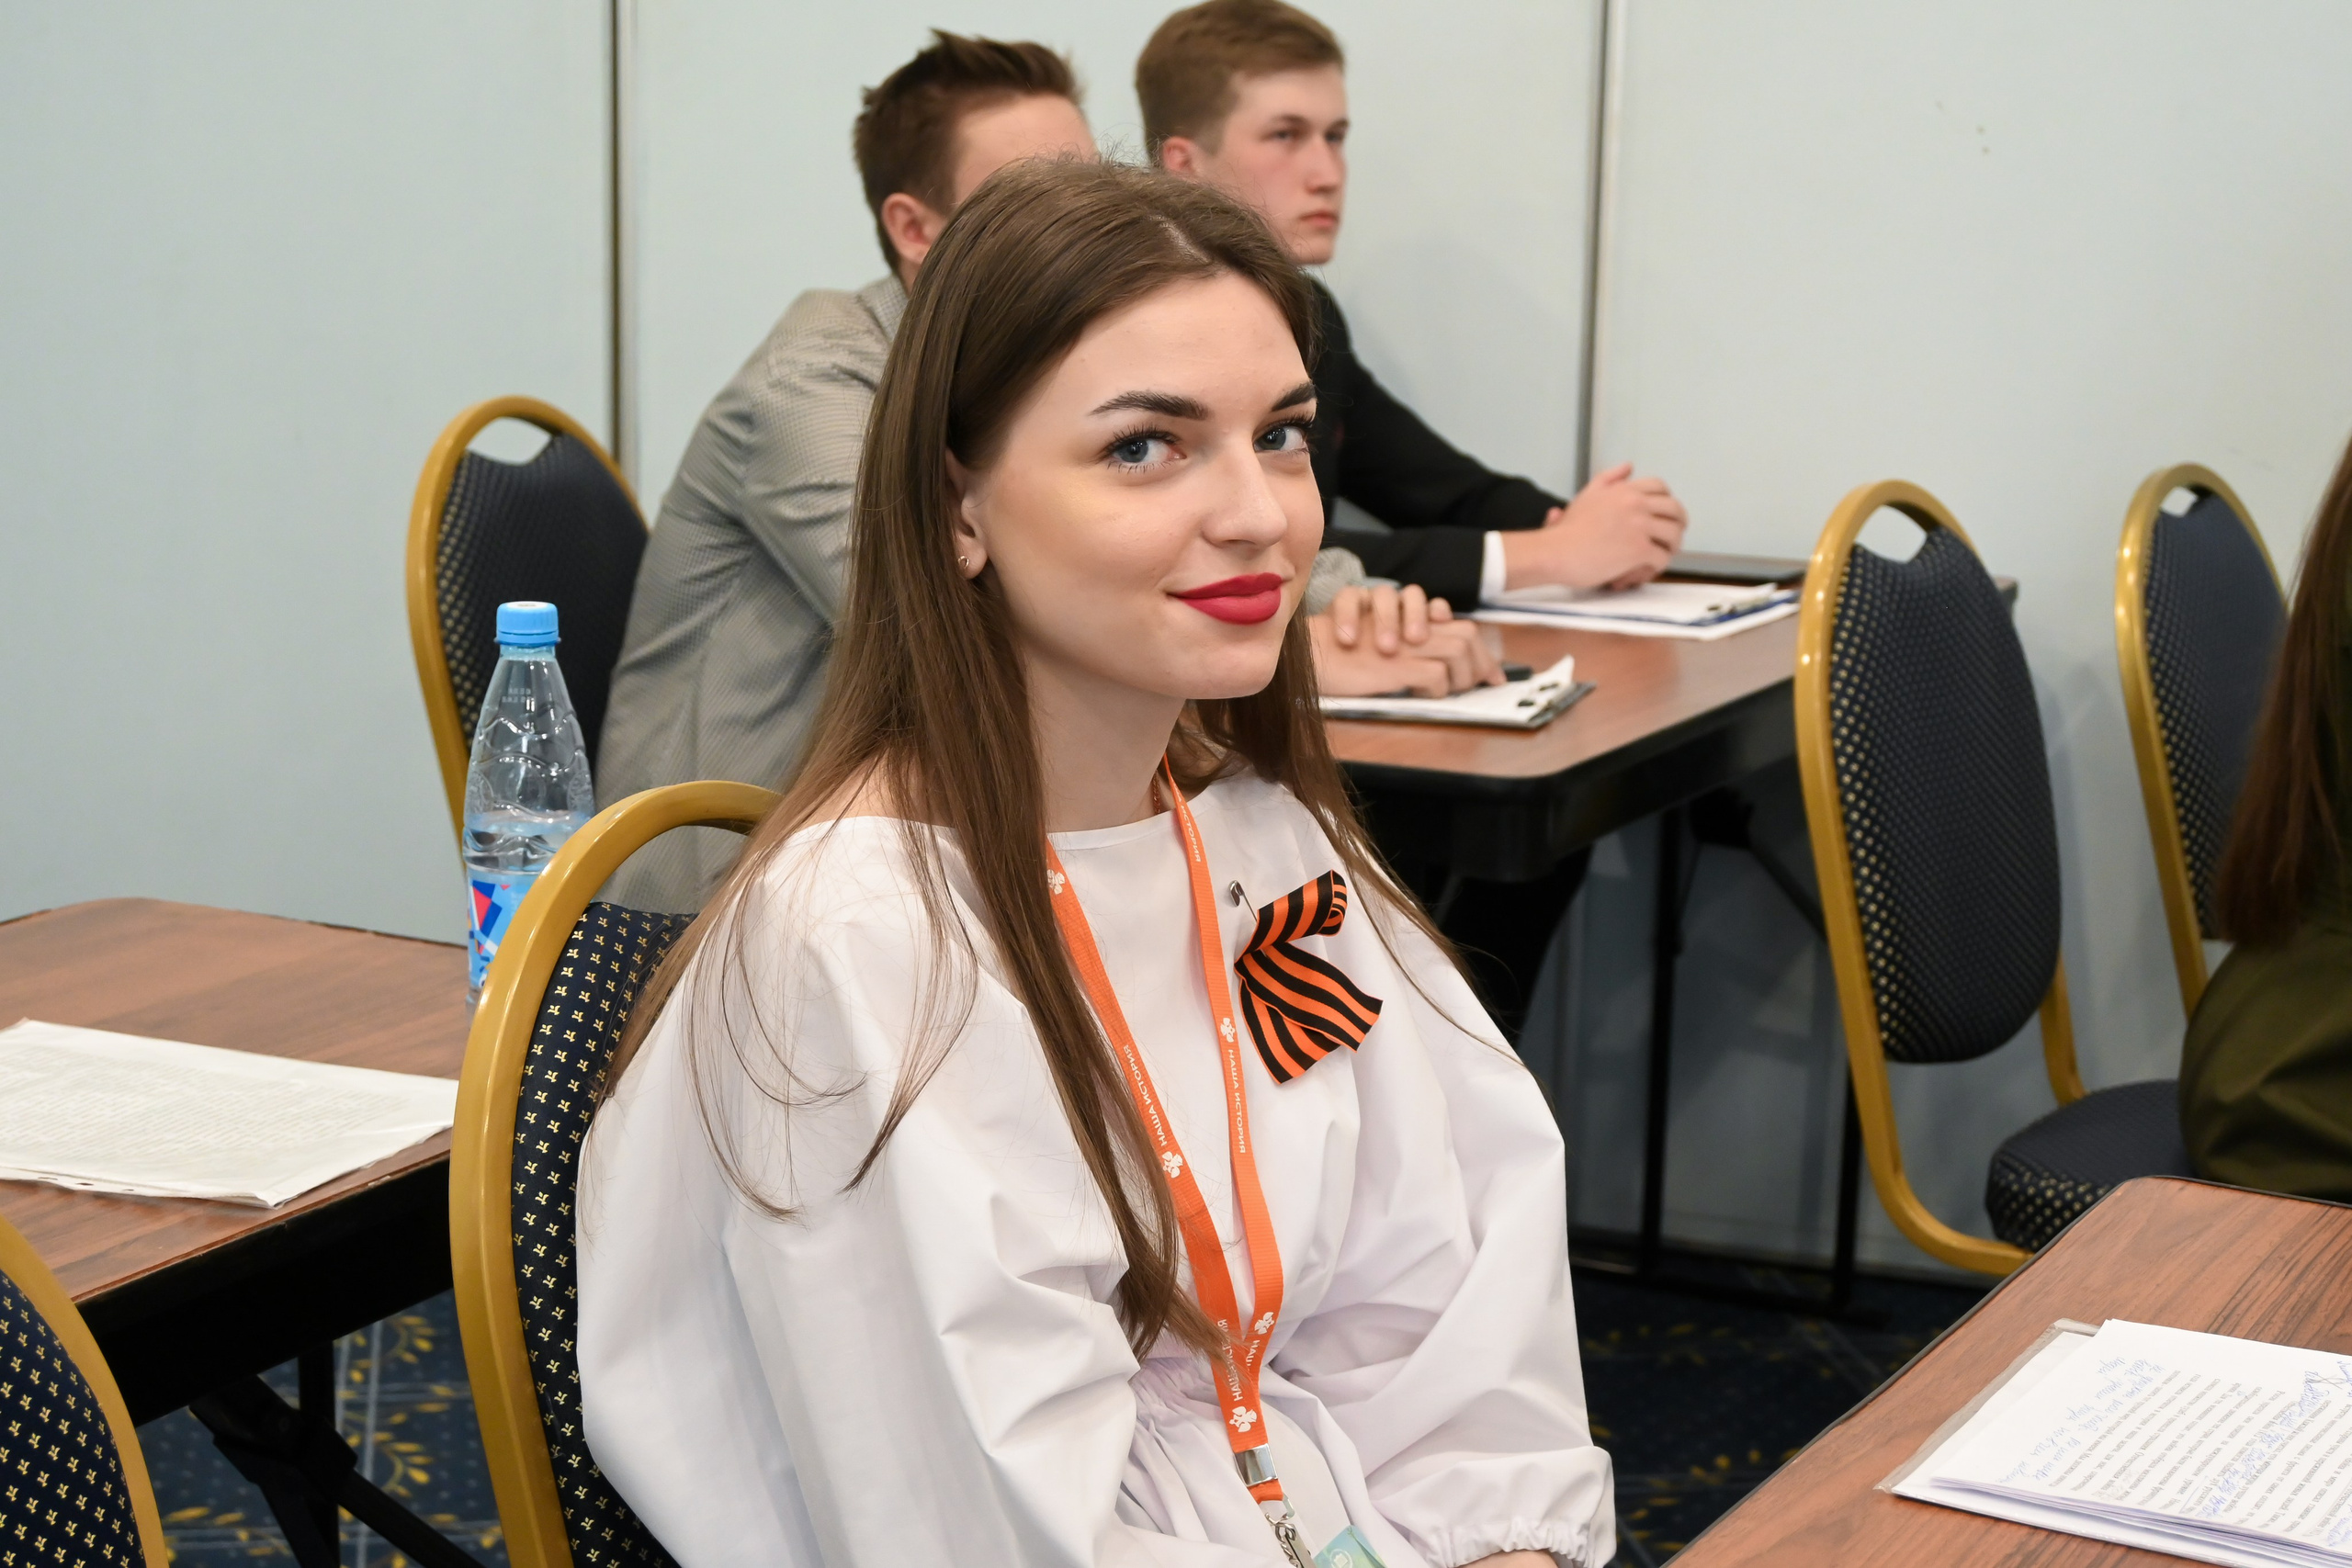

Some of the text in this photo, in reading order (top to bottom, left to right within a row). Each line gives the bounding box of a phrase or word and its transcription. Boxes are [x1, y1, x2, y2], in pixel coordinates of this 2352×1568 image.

[1181, 805, 1202, 863] ИСТОРИЯ
[1123, 1044, 1168, 1147] НАША ИСТОРИЯ
[1227, 1049, 1247, 1154] НАША ИСТОРИЯ
